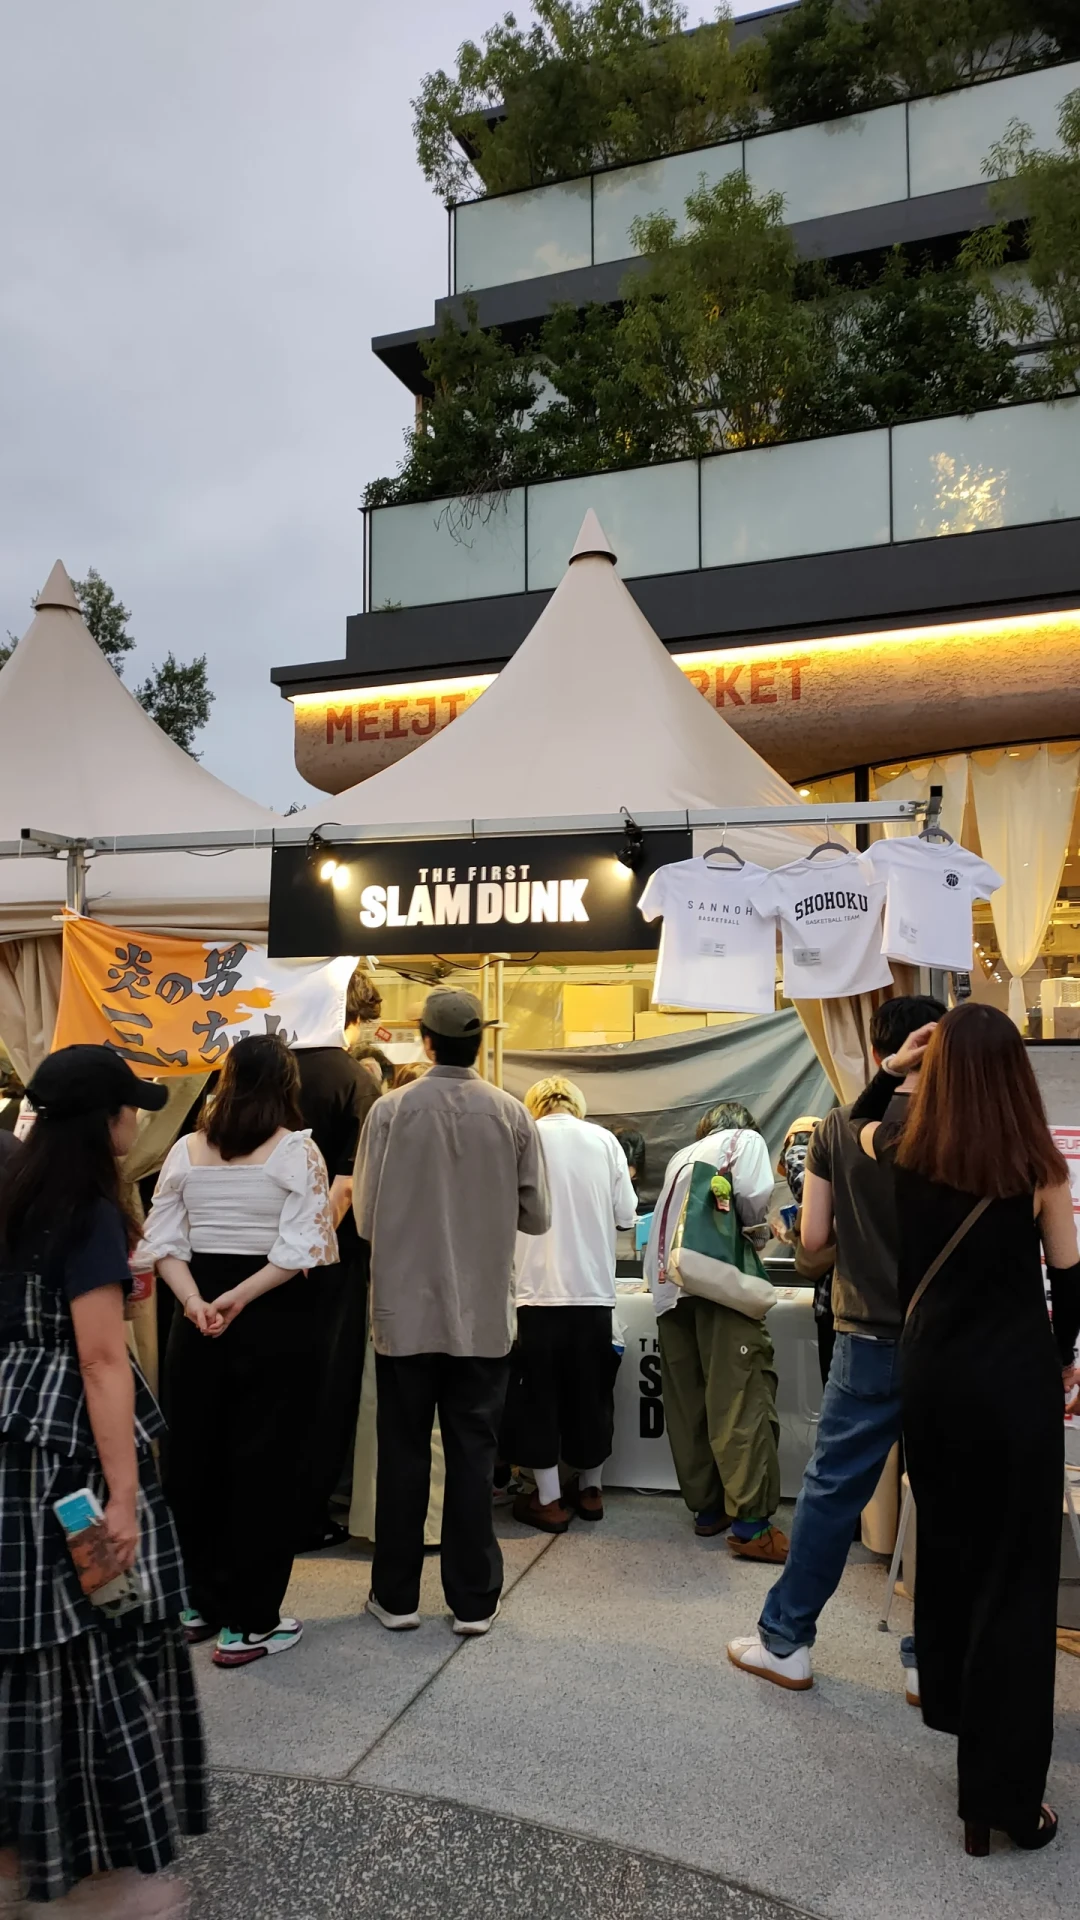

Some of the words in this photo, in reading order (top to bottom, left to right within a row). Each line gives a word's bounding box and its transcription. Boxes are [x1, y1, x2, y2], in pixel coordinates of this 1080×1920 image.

[326, 693, 466, 744] MEIJI
[418, 867, 456, 883] THE
[468, 864, 530, 881] FIRST
[359, 883, 471, 929] SLAM
[476, 878, 590, 925] DUNK
[687, 900, 753, 916] SANNOH
[794, 891, 868, 921] SHOHOKU
[698, 915, 740, 926] BASKETBALL
[805, 916, 843, 926] BASKETBALL
[843, 914, 860, 923] TEAM
[101, 942, 248, 1005] 炎の男
[639, 1338, 661, 1353] TH
